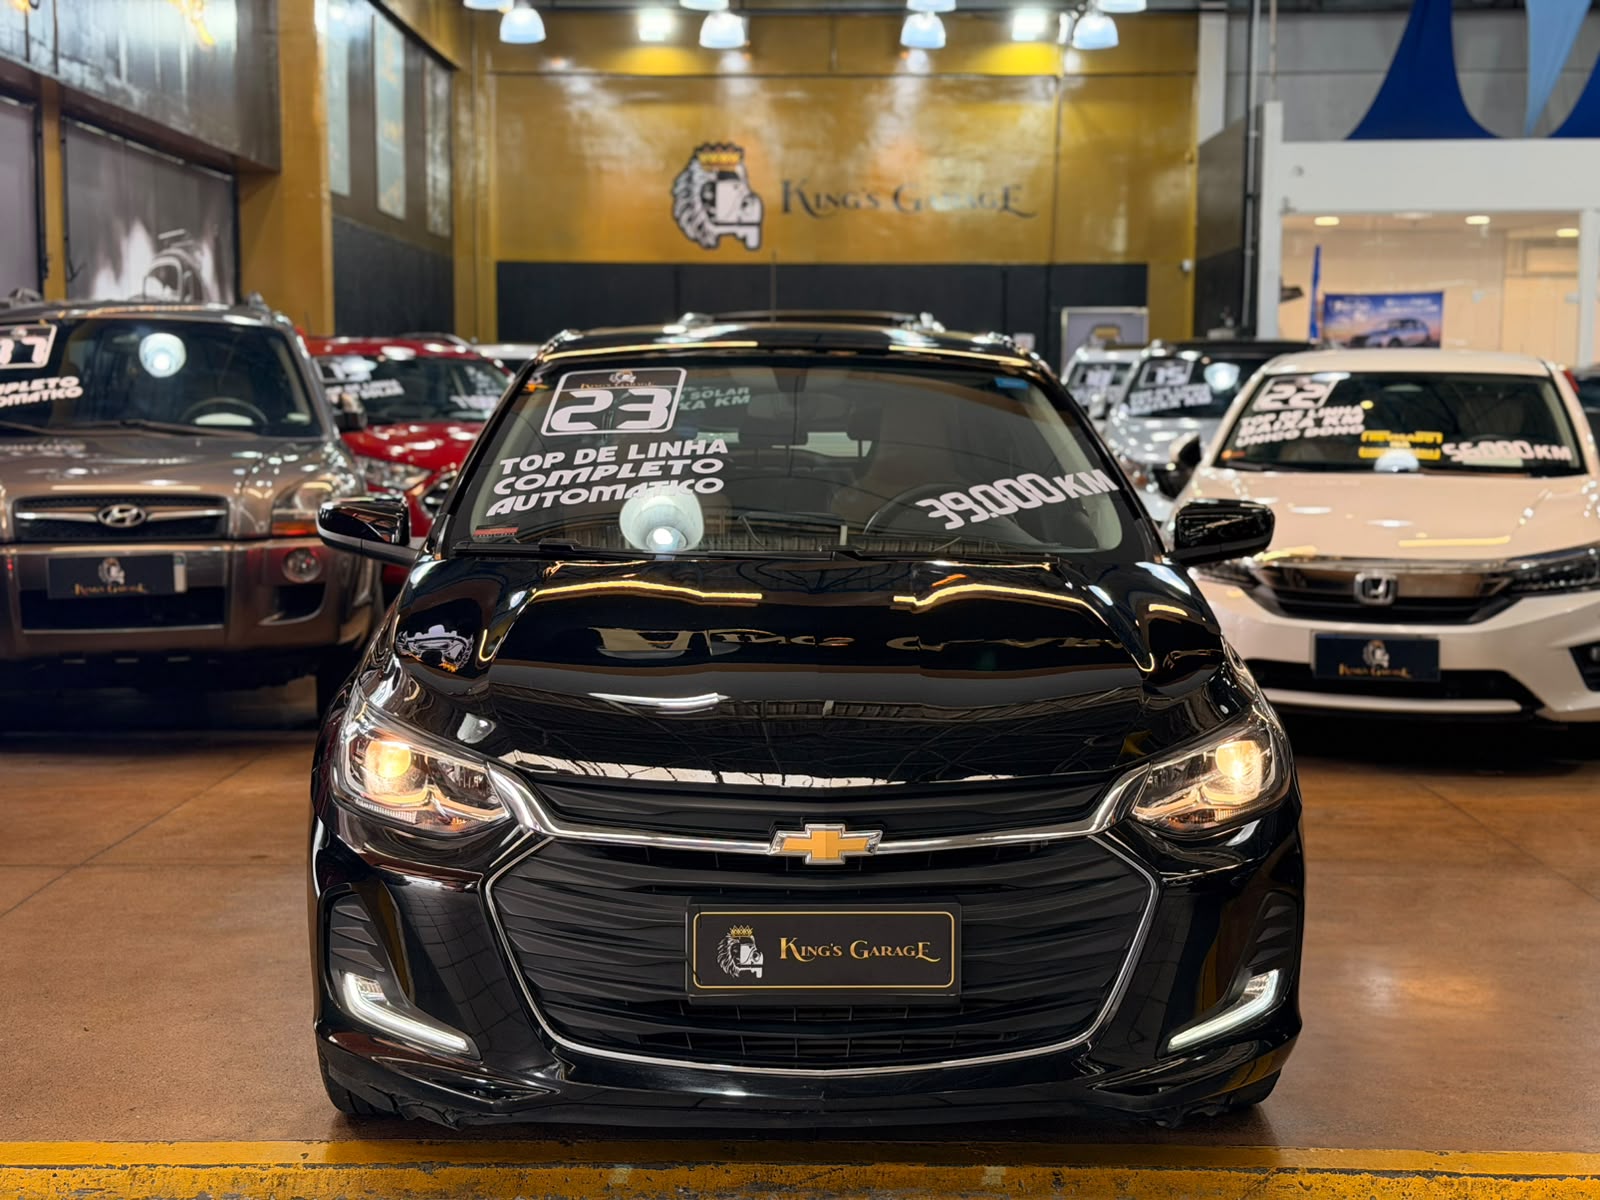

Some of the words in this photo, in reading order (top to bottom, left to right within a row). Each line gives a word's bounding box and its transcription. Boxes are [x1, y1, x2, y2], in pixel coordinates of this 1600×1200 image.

[0, 376, 79, 395] PLETO
[714, 394, 751, 407] KM
[1260, 383, 1328, 407] 22
[550, 388, 672, 431] 23
[500, 452, 565, 475] TOP
[573, 446, 618, 465] DE
[627, 438, 728, 460] LINHA
[493, 458, 724, 495] COMPLETO
[485, 477, 725, 518] AUTOMATICO
[779, 937, 842, 962] KING'S
[849, 940, 941, 962] GARAGE
